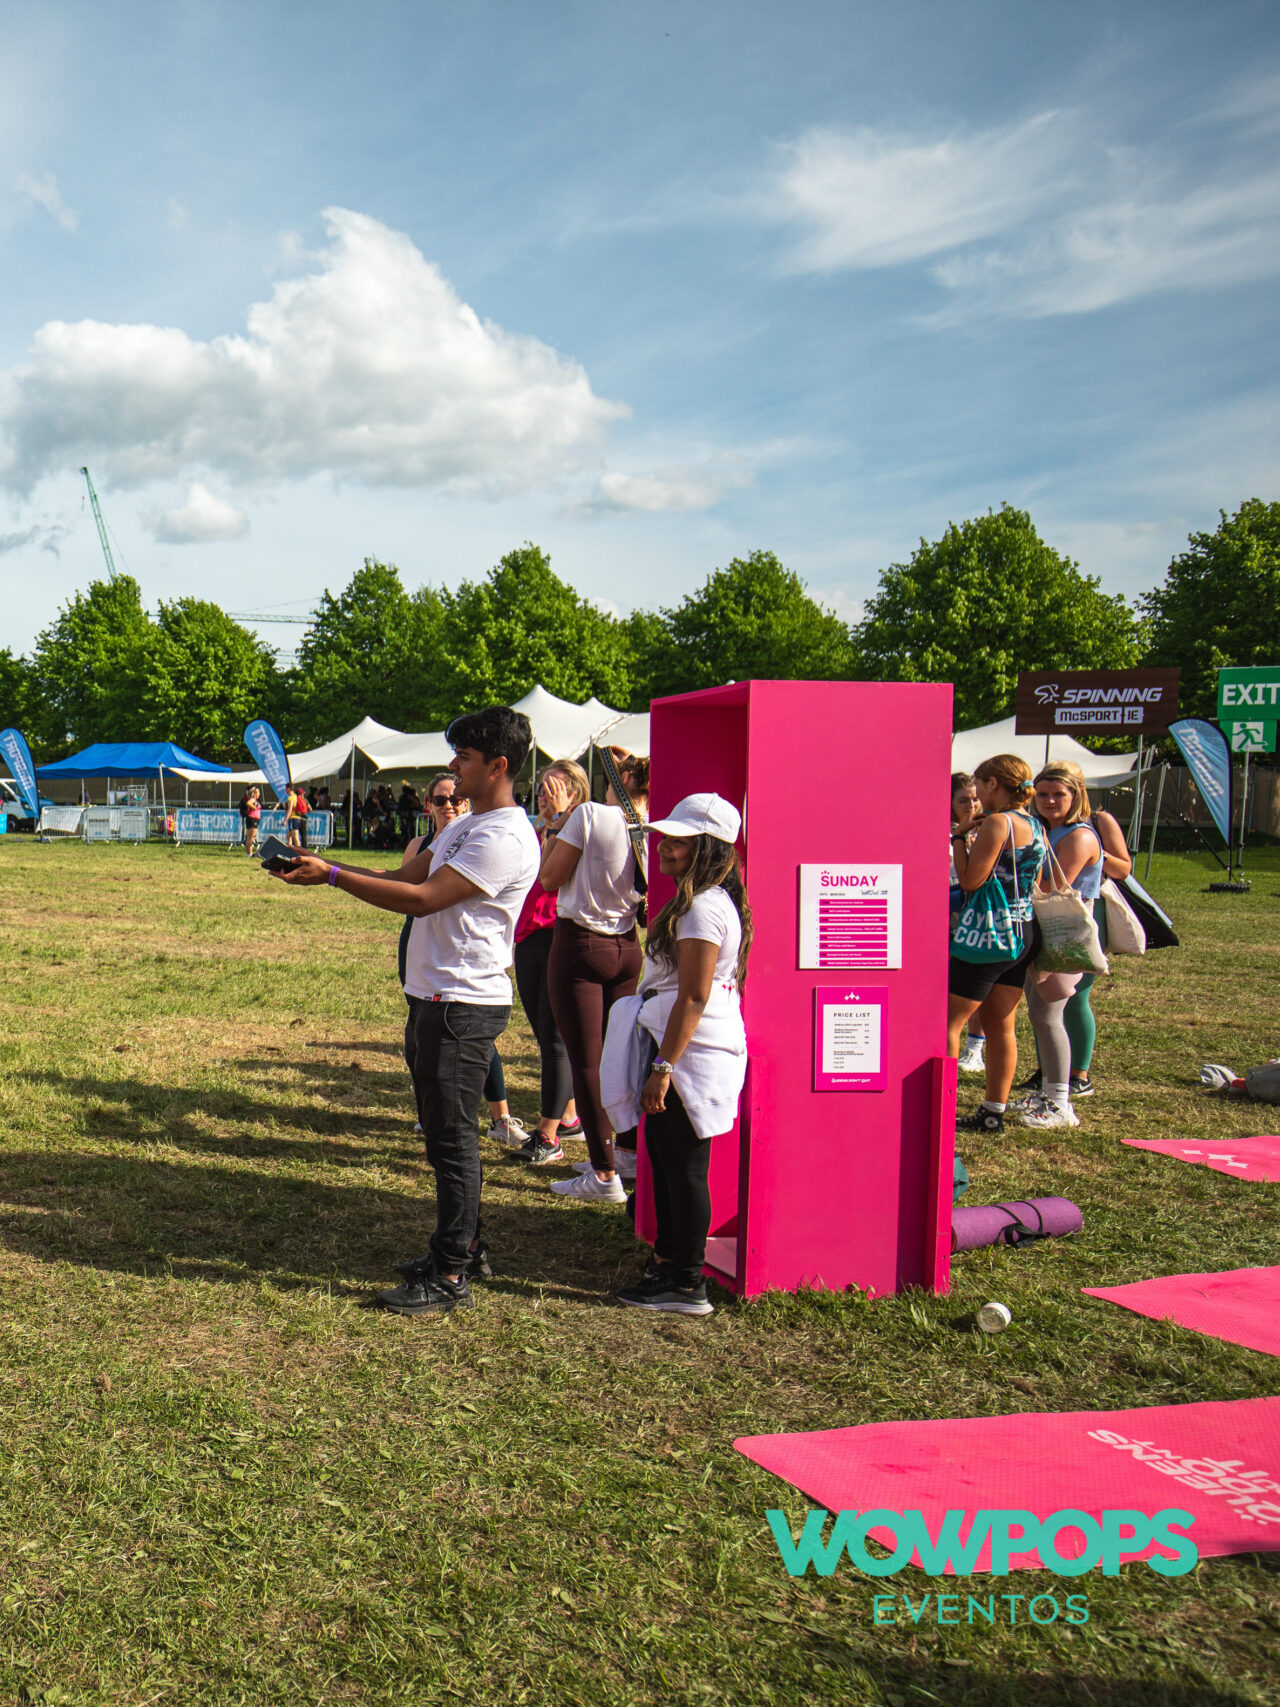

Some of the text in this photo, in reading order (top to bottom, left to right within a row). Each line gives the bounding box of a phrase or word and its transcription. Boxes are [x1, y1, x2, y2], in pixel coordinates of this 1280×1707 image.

[1061, 687, 1163, 704] SPINNING
[1222, 683, 1280, 706] EXIT
[1060, 710, 1139, 721] McSPORT IE
[820, 875, 879, 887] SUNDAY
[1201, 1457, 1280, 1495] UIT
